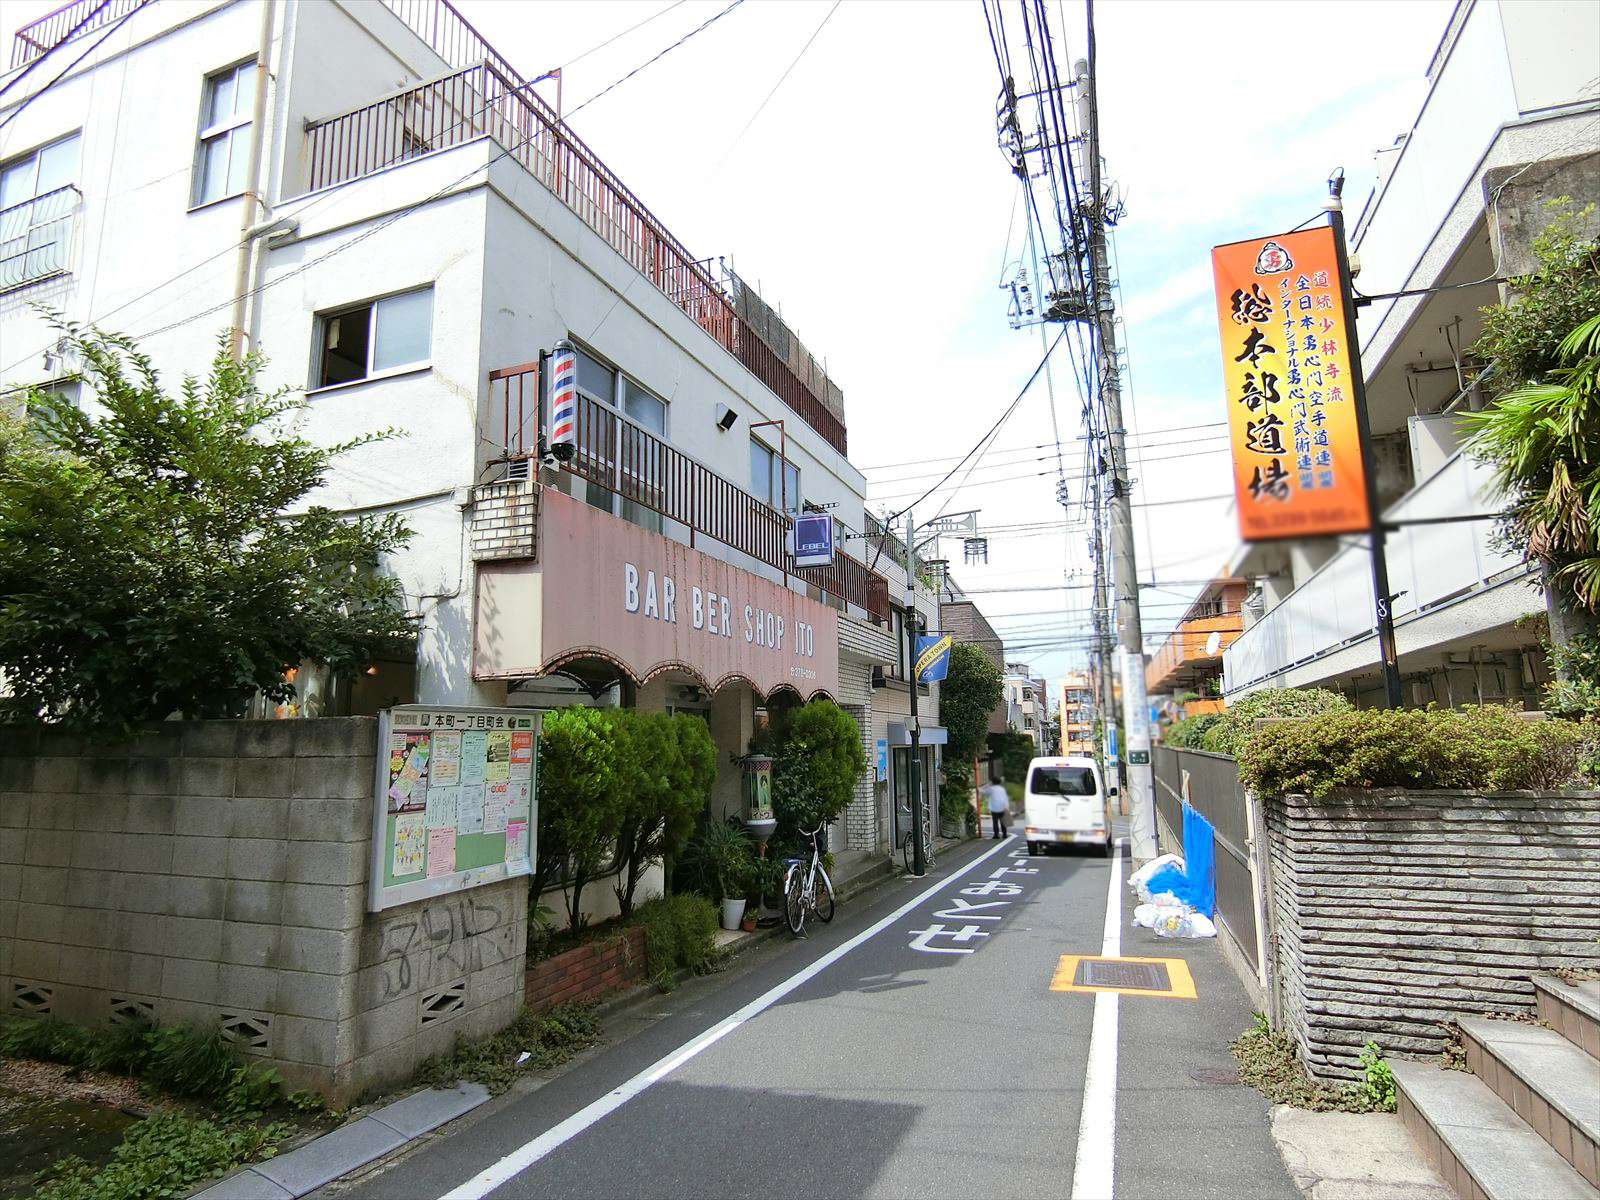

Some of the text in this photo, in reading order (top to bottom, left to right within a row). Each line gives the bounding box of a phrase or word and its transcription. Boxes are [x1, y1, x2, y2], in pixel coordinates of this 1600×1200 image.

[744, 604, 785, 650] SHOP
[795, 621, 814, 658] ITO
[930, 641, 947, 656] TOWN
[435, 714, 504, 728] 本町一丁目町会
